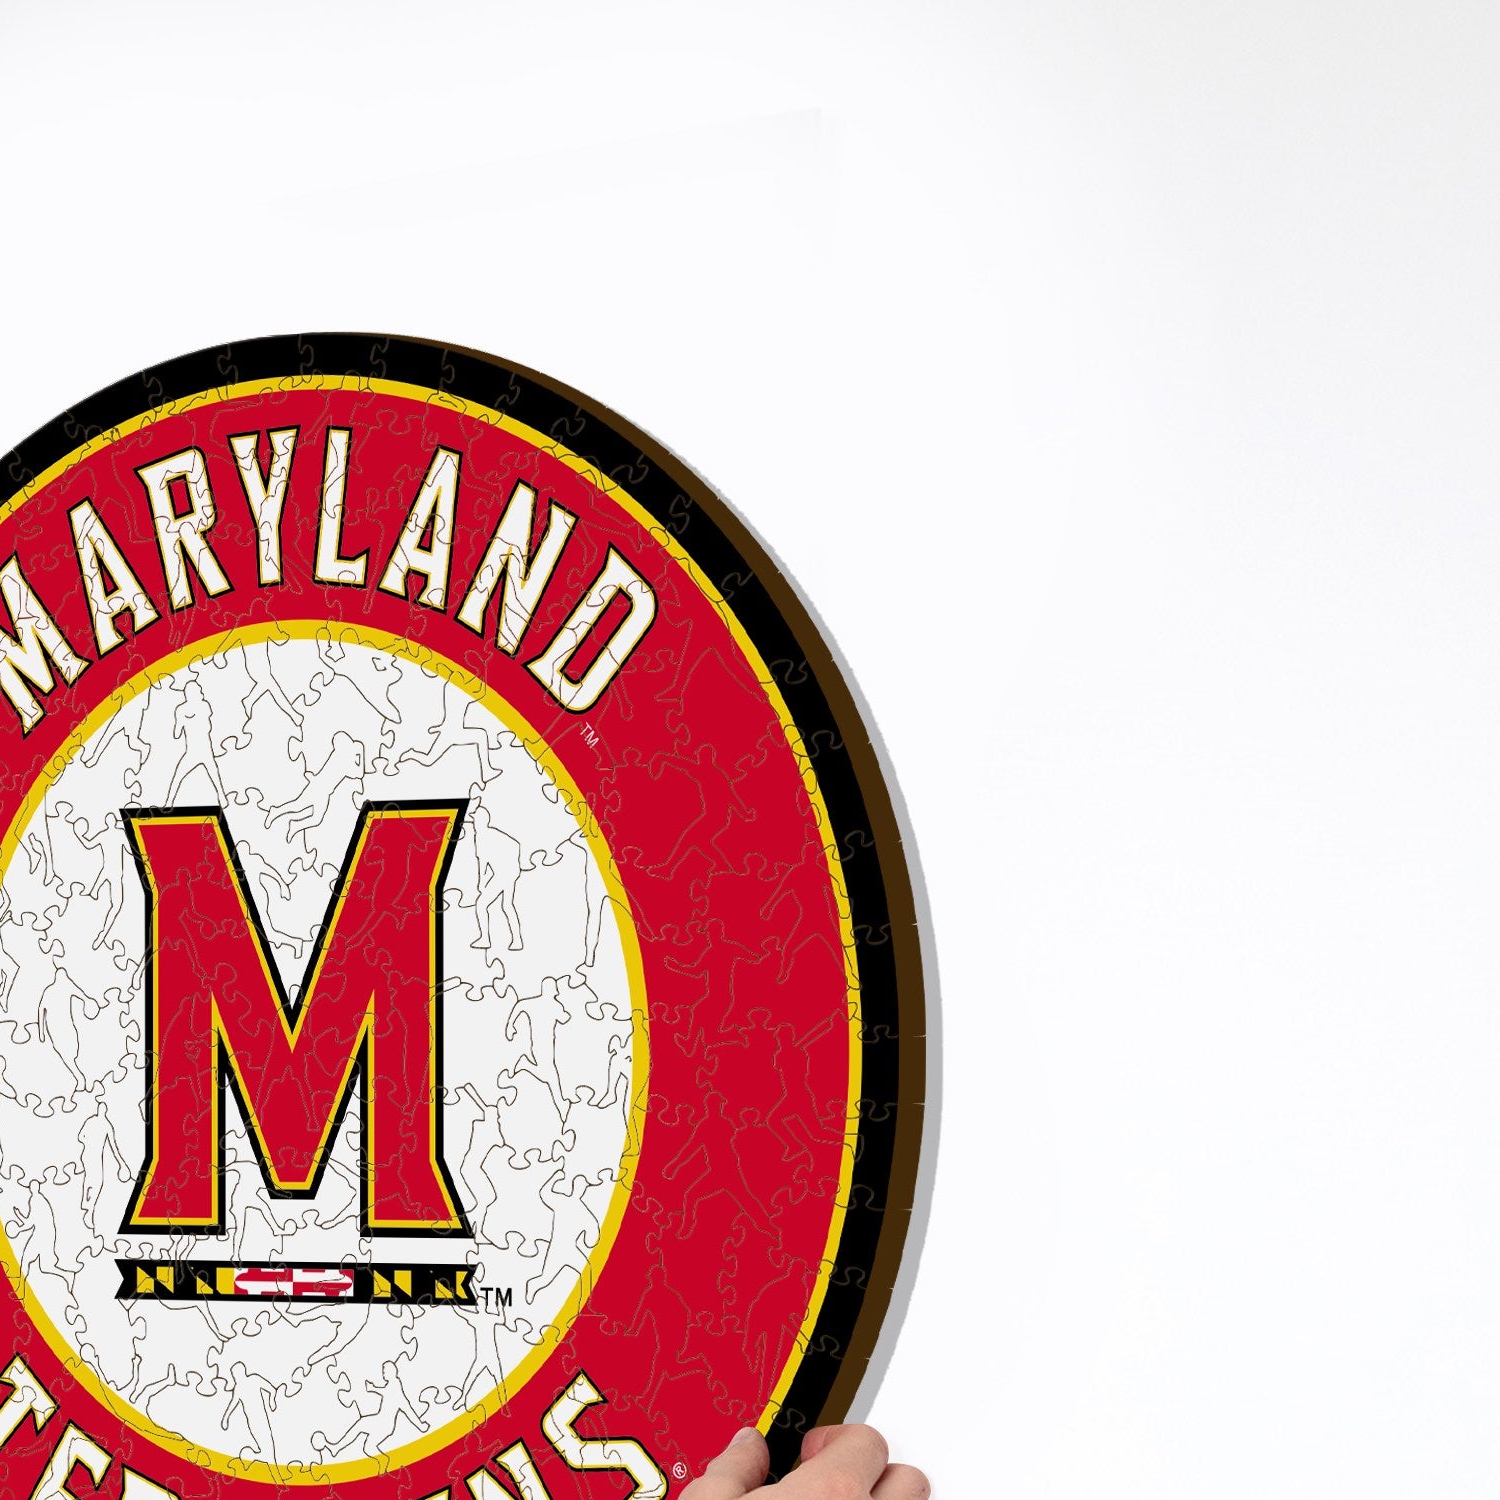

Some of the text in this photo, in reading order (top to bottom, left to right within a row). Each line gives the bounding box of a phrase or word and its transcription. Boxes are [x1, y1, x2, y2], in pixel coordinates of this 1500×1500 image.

[580, 721, 599, 748] TM
[117, 798, 475, 1238] M
[480, 1287, 512, 1307] TM
